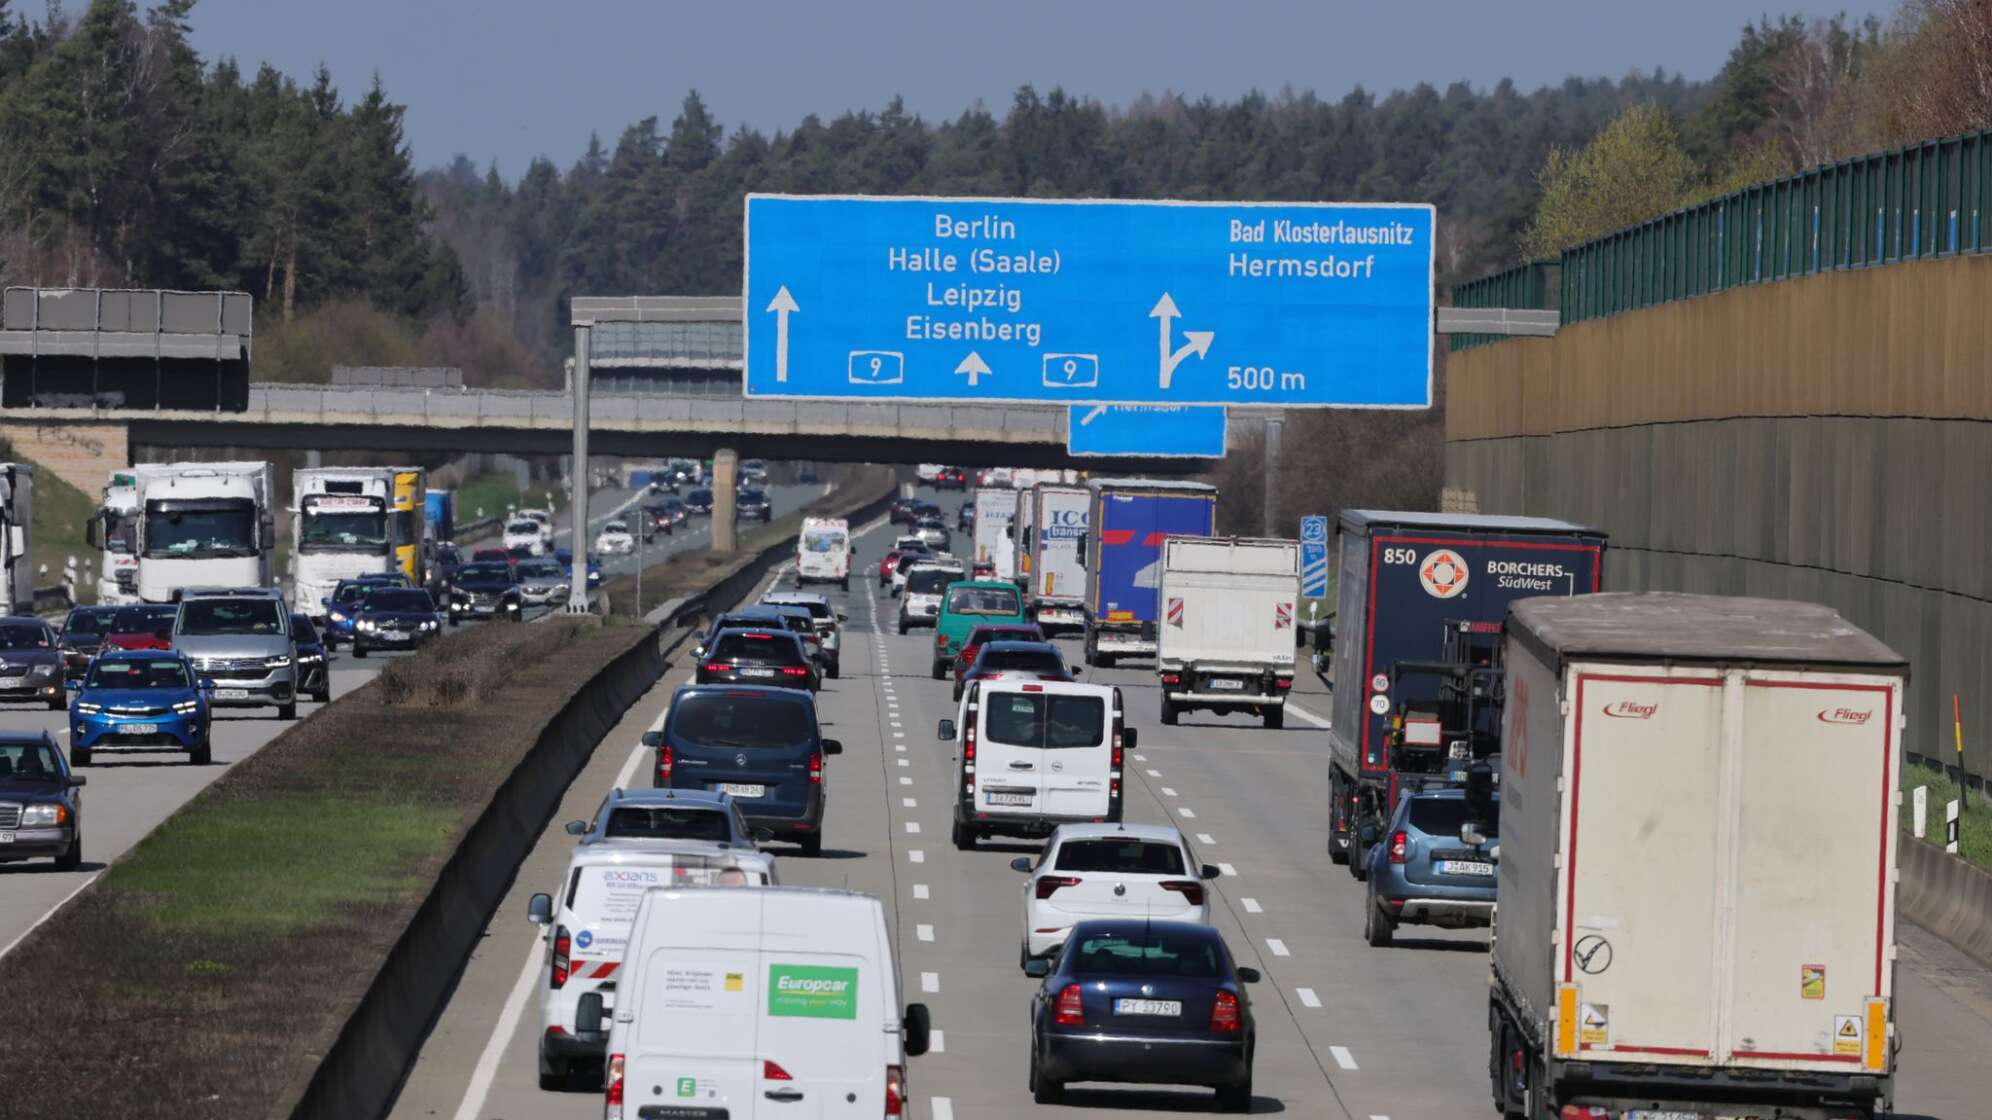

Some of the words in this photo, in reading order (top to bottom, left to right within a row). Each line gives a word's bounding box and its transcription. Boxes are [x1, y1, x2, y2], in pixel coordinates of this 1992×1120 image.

[935, 214, 1015, 240] Berlin
[1230, 219, 1265, 243] Bad
[1274, 220, 1413, 245] Klosterlausnitz
[889, 247, 957, 273] Halle
[970, 248, 1060, 275] (Saale)
[1228, 253, 1374, 278] Hermsdorf
[927, 282, 1021, 312] Leipzig
[906, 315, 1041, 346] Eisenberg
[870, 357, 882, 377] 9
[1064, 359, 1077, 380] 9
[1228, 366, 1274, 390] 500
[1281, 372, 1305, 391] m
[1305, 522, 1322, 536] 23
[1384, 548, 1416, 565] 850
[1487, 560, 1564, 577] BORCHERS
[1497, 575, 1552, 591] SüdWest
[778, 974, 849, 993] Europcar
